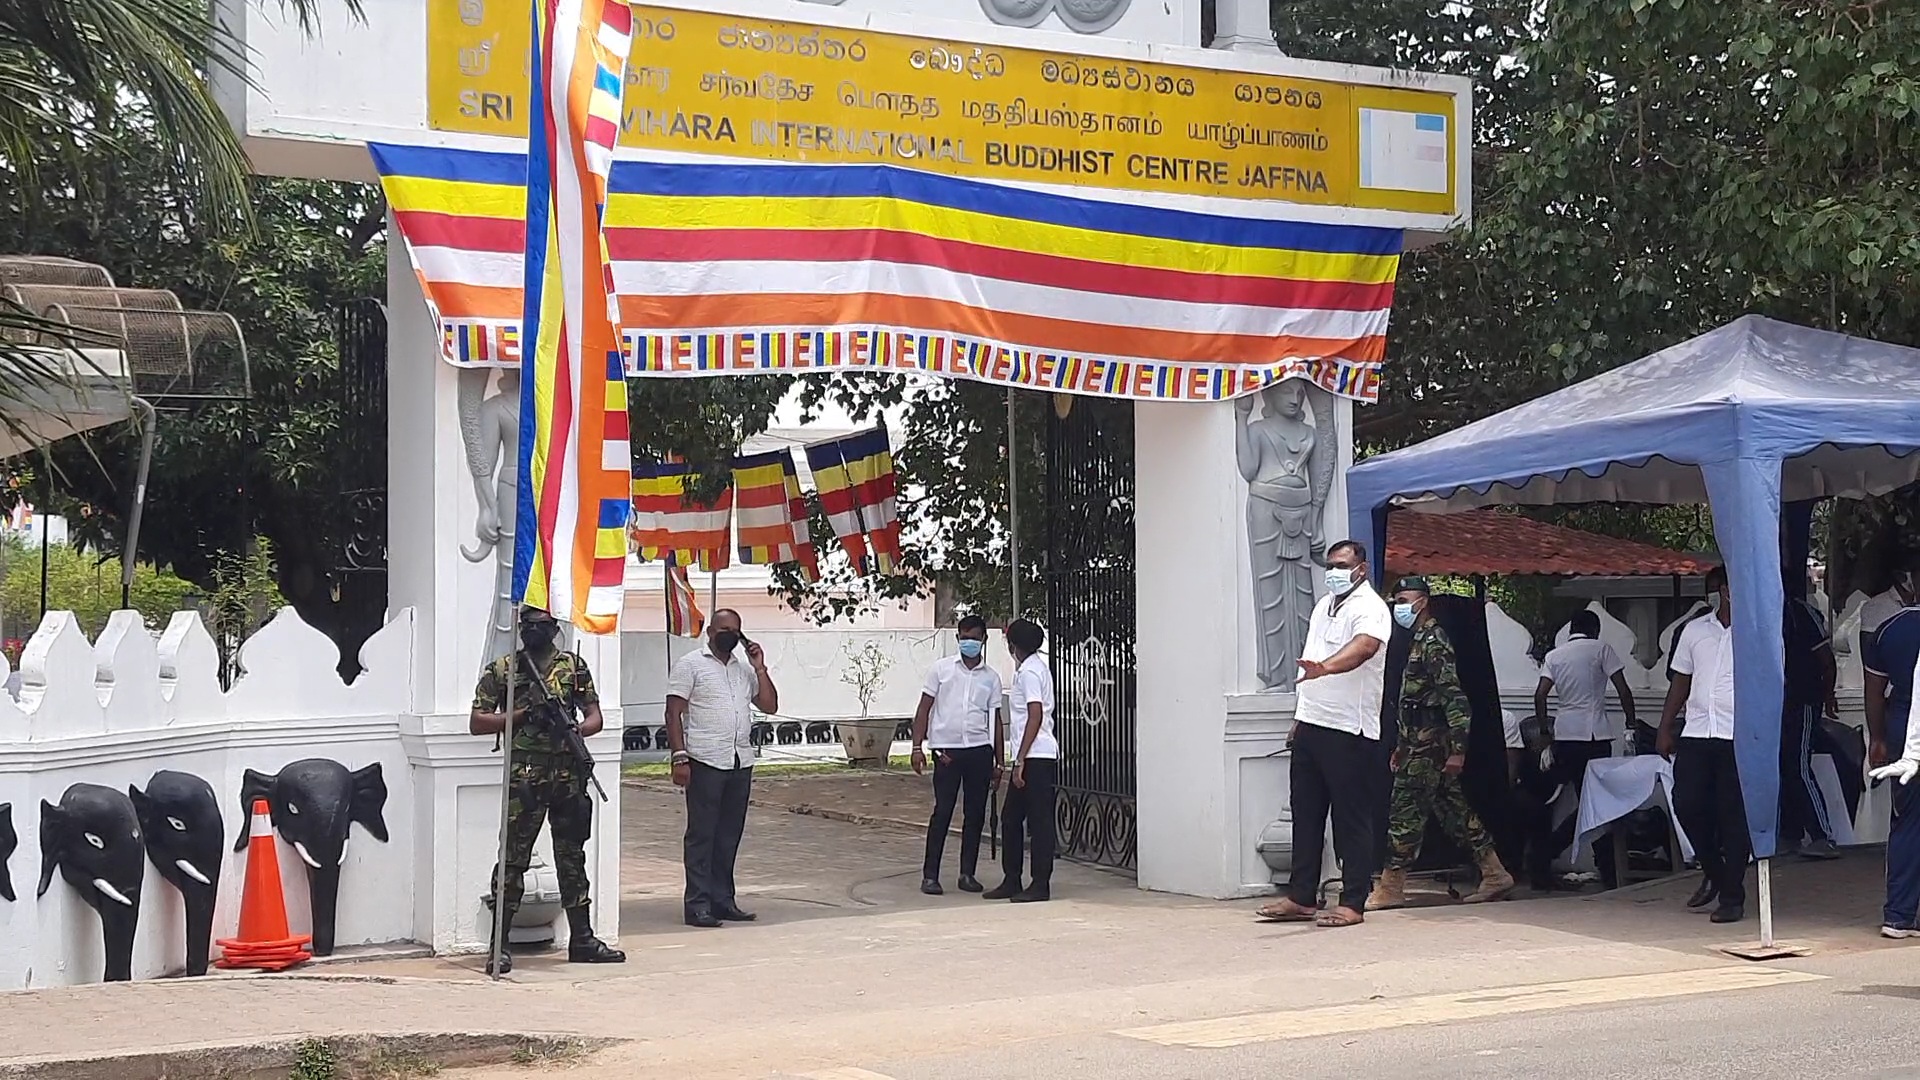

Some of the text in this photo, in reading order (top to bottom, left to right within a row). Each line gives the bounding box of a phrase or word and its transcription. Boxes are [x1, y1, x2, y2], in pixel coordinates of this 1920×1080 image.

[699, 69, 815, 103] சர்வதேச
[1188, 120, 1330, 151] யாழ்ப்பாணம்
[1234, 82, 1323, 109] යාපනය
[458, 88, 514, 121] SRI
[751, 118, 975, 164] INTERNATIONAL
[984, 141, 1115, 176] BUDDHIST
[1127, 153, 1229, 185] CENTRE
[1237, 164, 1330, 194] JAFFNA
